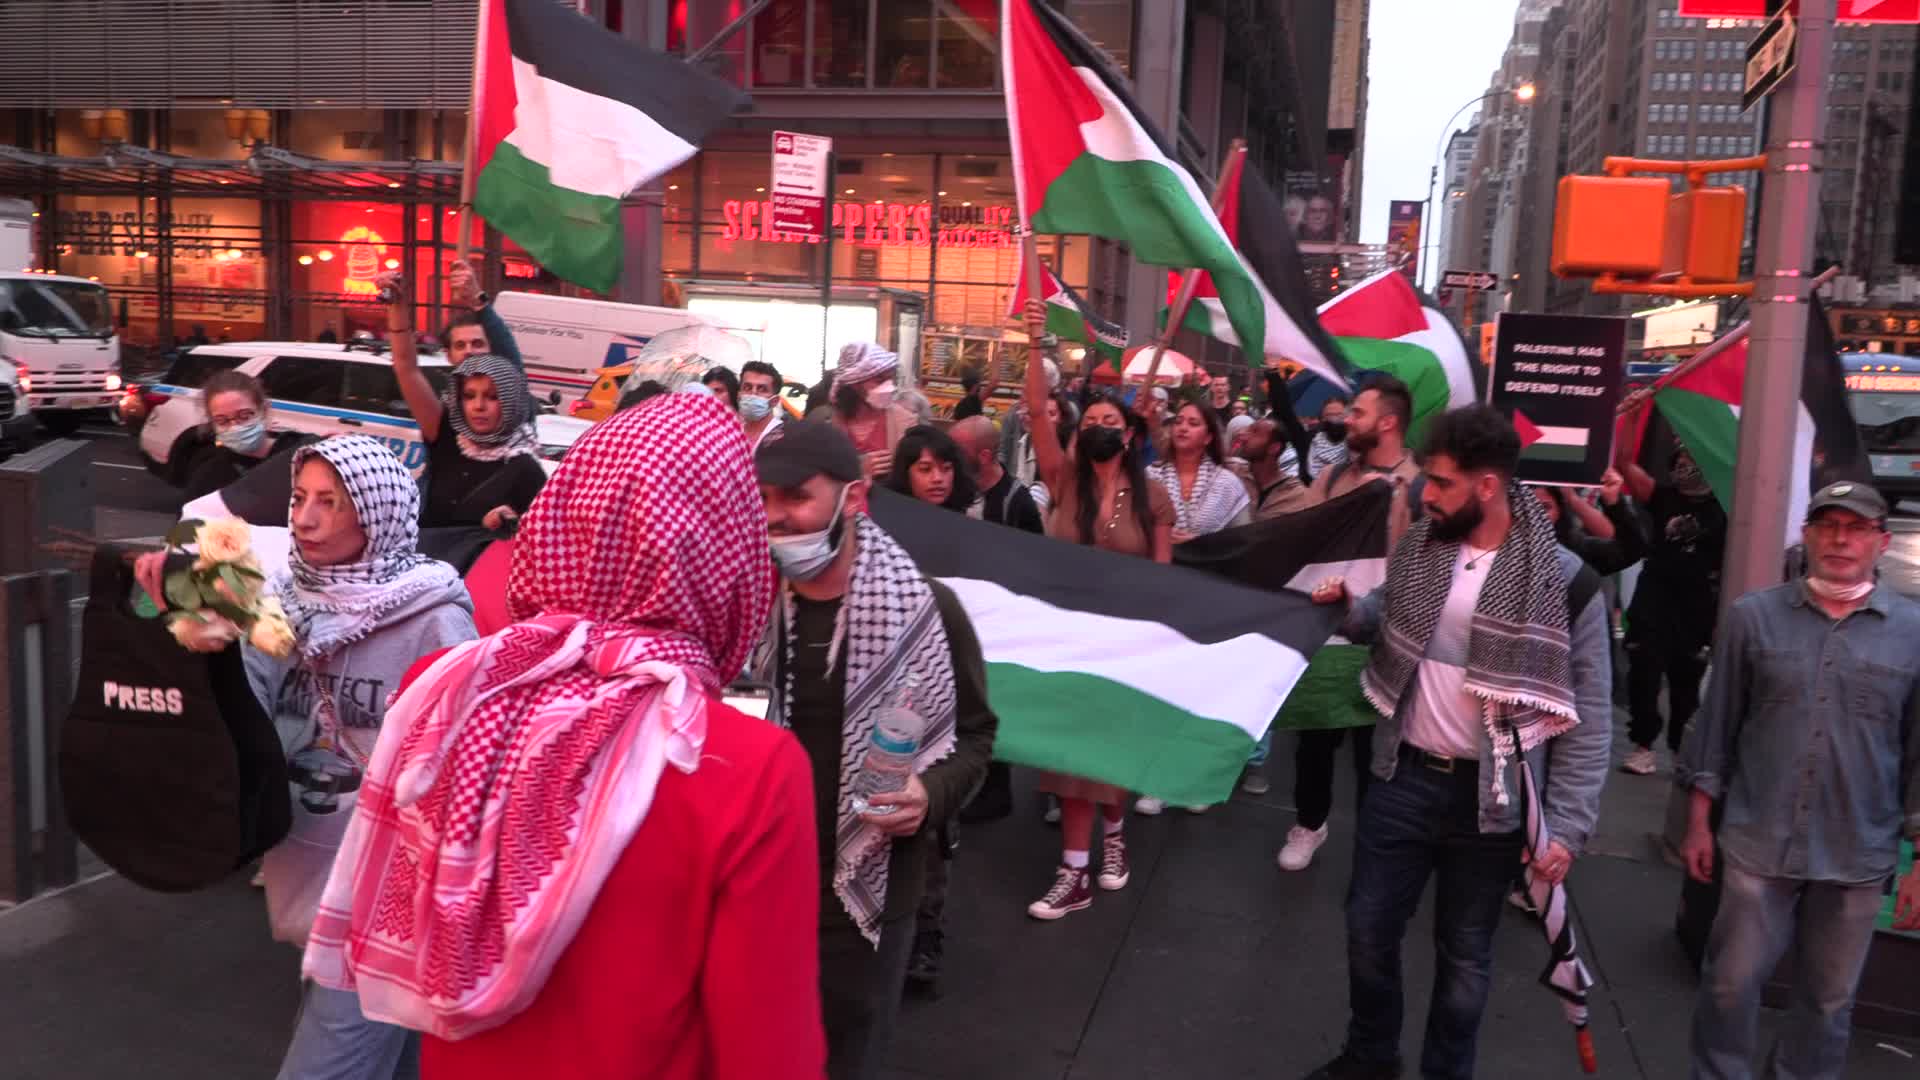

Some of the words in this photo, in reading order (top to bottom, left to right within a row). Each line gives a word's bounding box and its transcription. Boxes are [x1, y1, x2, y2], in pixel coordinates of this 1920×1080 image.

[939, 205, 1012, 225] QUALITY
[937, 228, 1012, 249] KITCHEN
[1513, 343, 1576, 356] PALESTINE
[1577, 346, 1605, 357] HAS
[1512, 361, 1540, 373] THE
[1540, 363, 1581, 375] RIGHT
[1582, 366, 1602, 376] TO
[1504, 380, 1559, 394] DEFEND
[1560, 385, 1606, 397] ITSELF
[103, 680, 183, 716] PRESS
